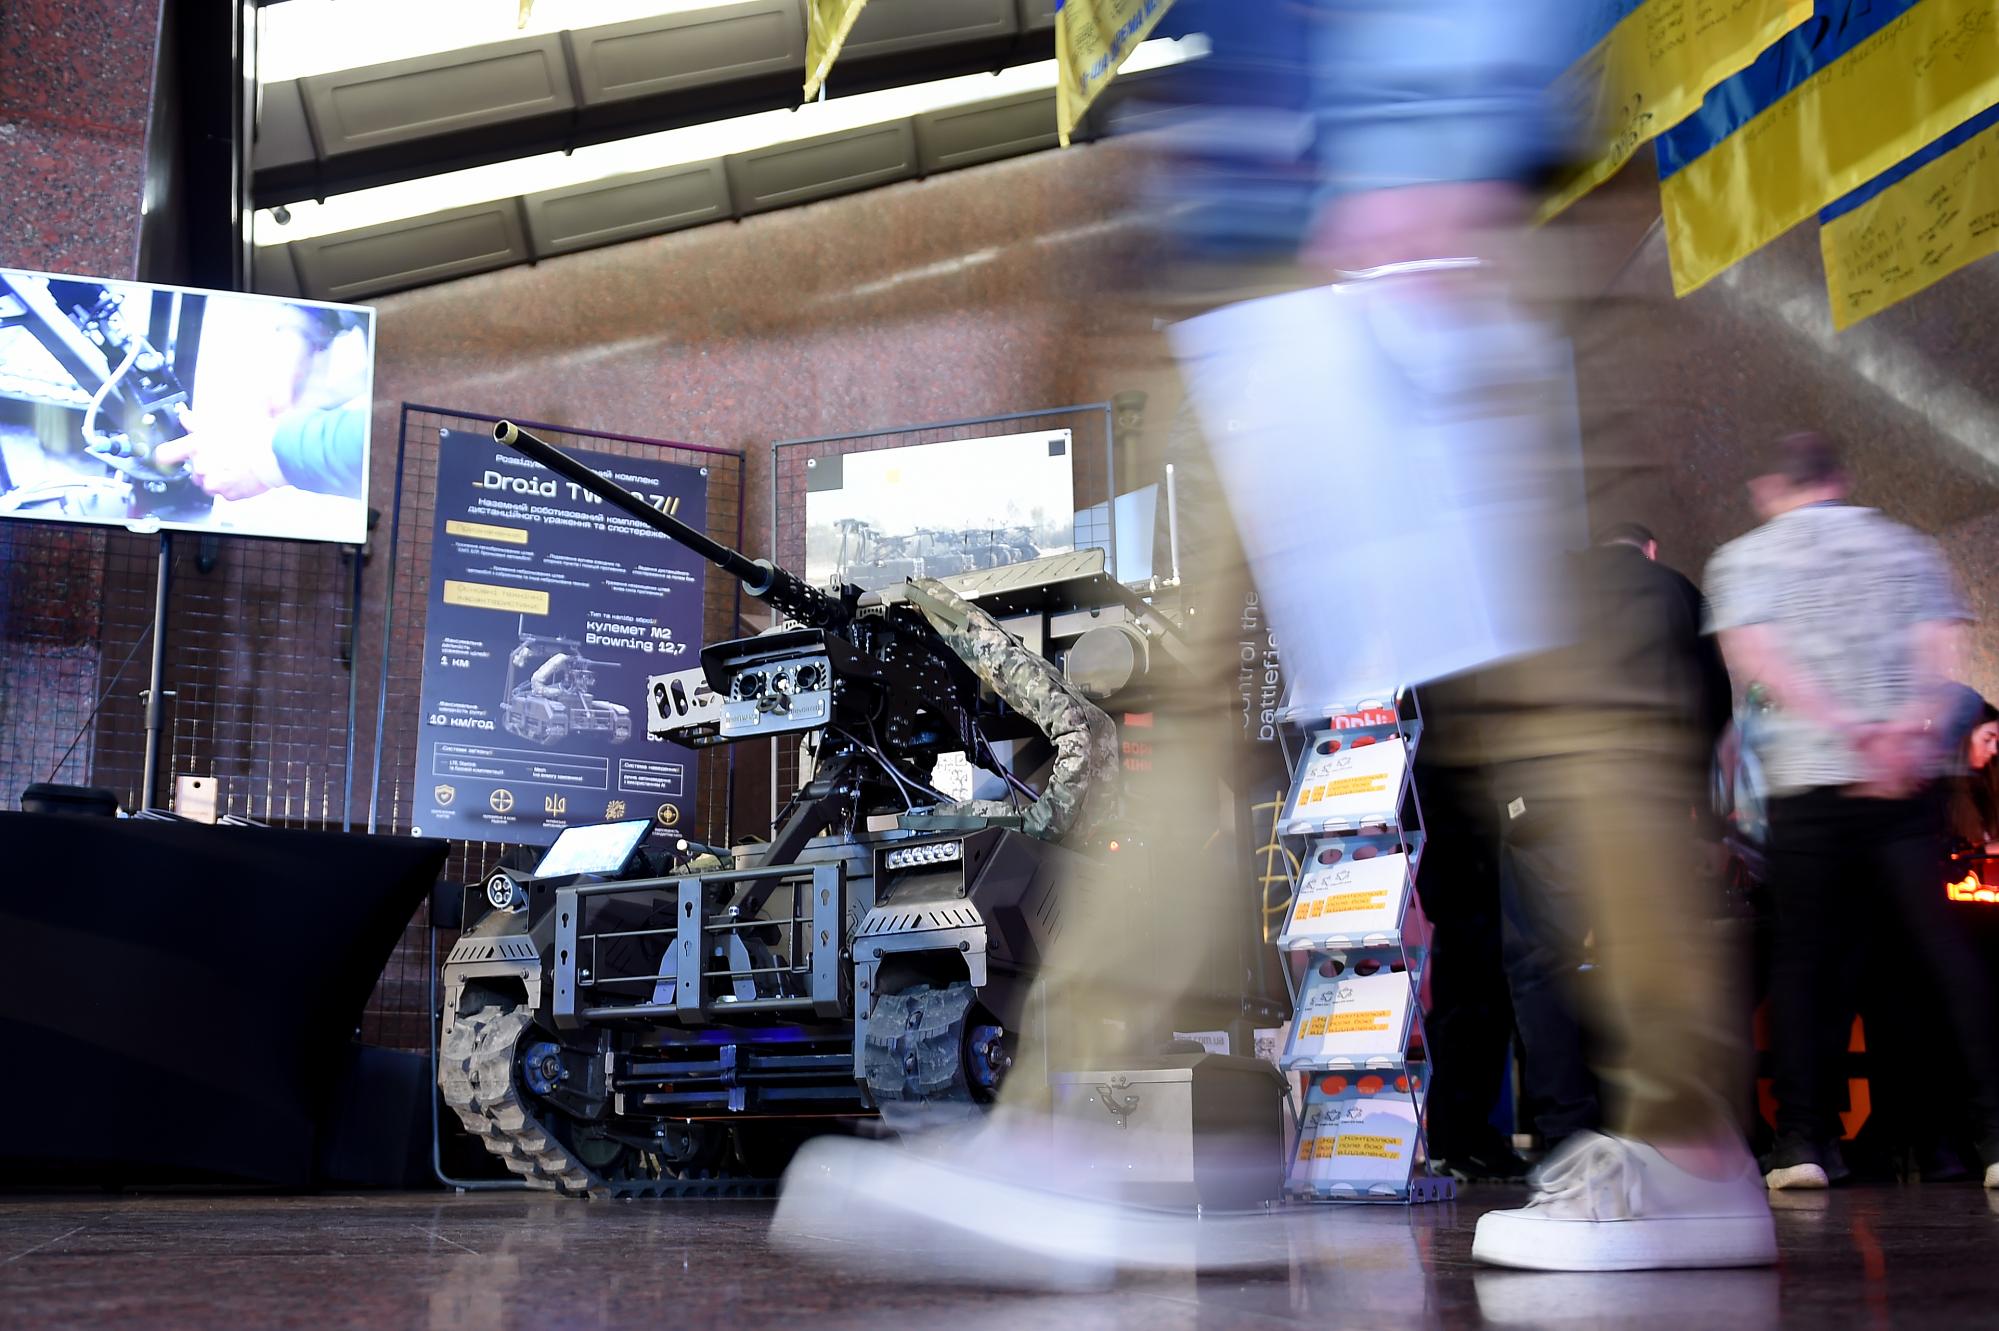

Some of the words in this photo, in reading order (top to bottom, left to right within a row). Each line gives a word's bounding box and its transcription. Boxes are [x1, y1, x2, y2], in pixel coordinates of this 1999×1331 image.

[614, 472, 660, 486] комплекс
[467, 505, 541, 521] дистанційного
[543, 516, 591, 528] ураження
[593, 522, 605, 530] та
[478, 497, 528, 512] Наземний
[530, 505, 604, 522] роботизований
[606, 516, 652, 529] комплек
[1241, 591, 1259, 630] the
[586, 621, 646, 637] кулемет
[585, 632, 654, 653] Browning
[658, 641, 686, 656] 12,7
[440, 655, 448, 665] 1
[452, 658, 470, 668] км
[430, 714, 447, 725] 10
[450, 717, 495, 730] км/год
